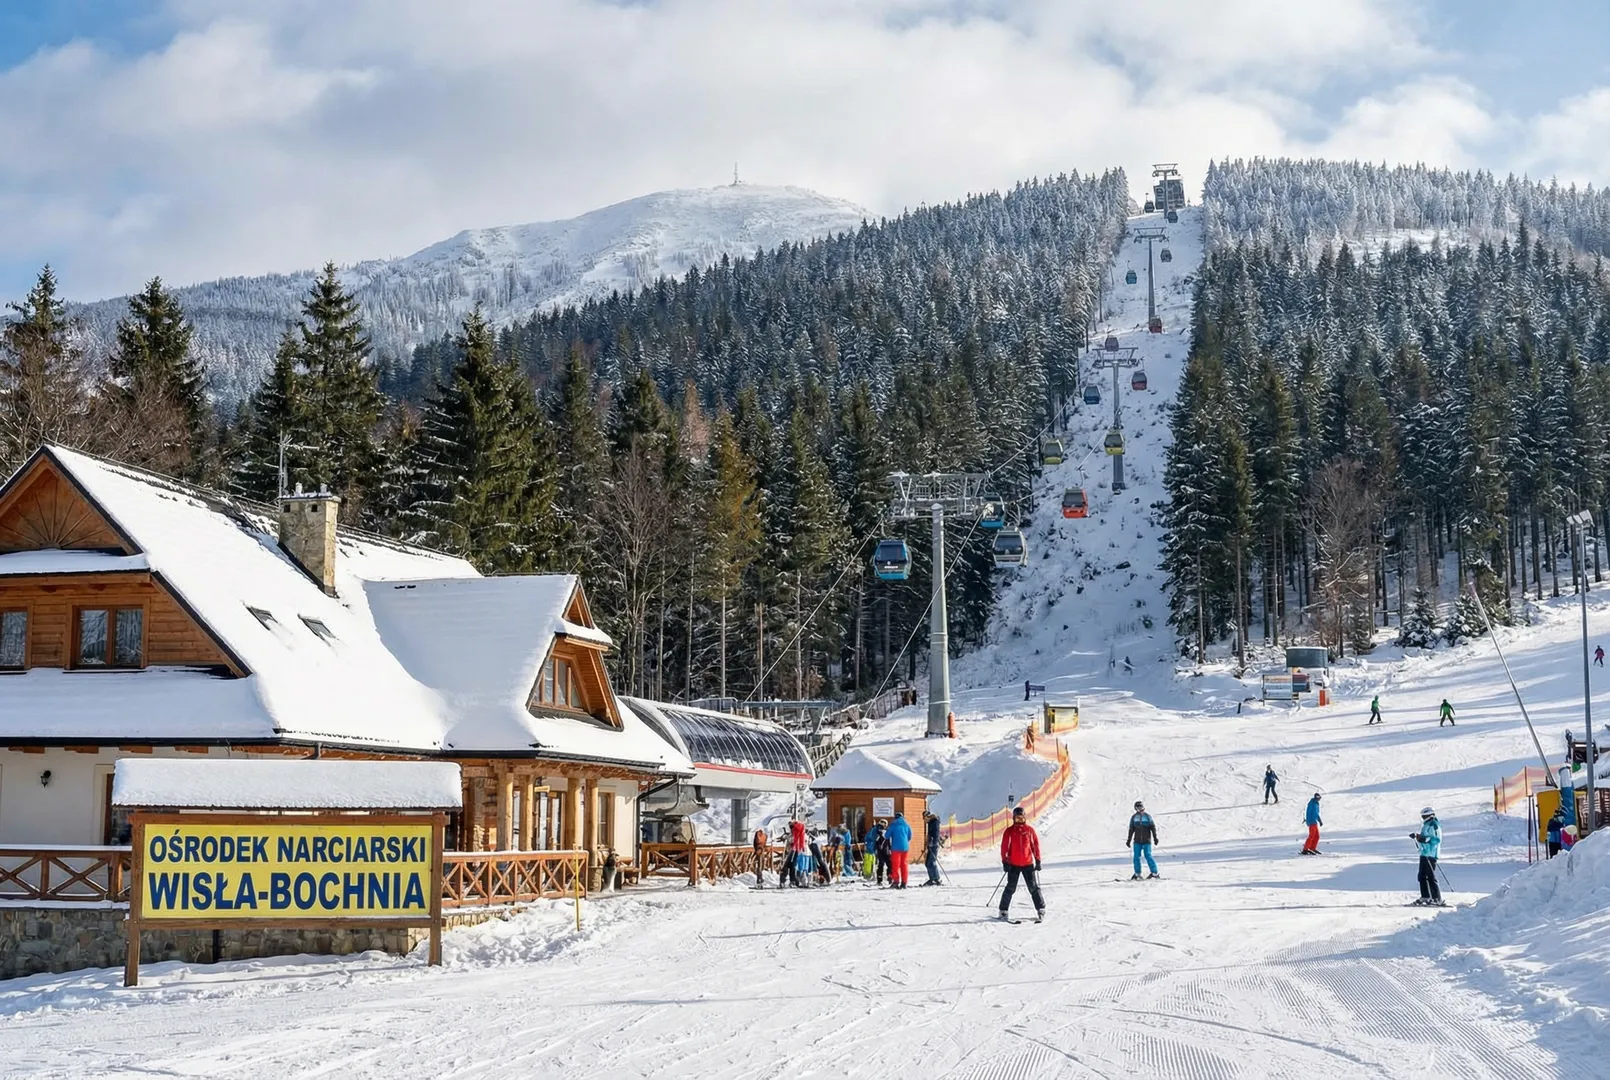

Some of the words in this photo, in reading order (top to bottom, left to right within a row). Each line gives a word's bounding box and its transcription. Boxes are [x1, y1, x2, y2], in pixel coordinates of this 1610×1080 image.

[150, 829, 269, 863] OŚRODEK
[277, 836, 426, 863] NARCIARSKI
[149, 872, 426, 910] WISŁA-BOCHNIA
